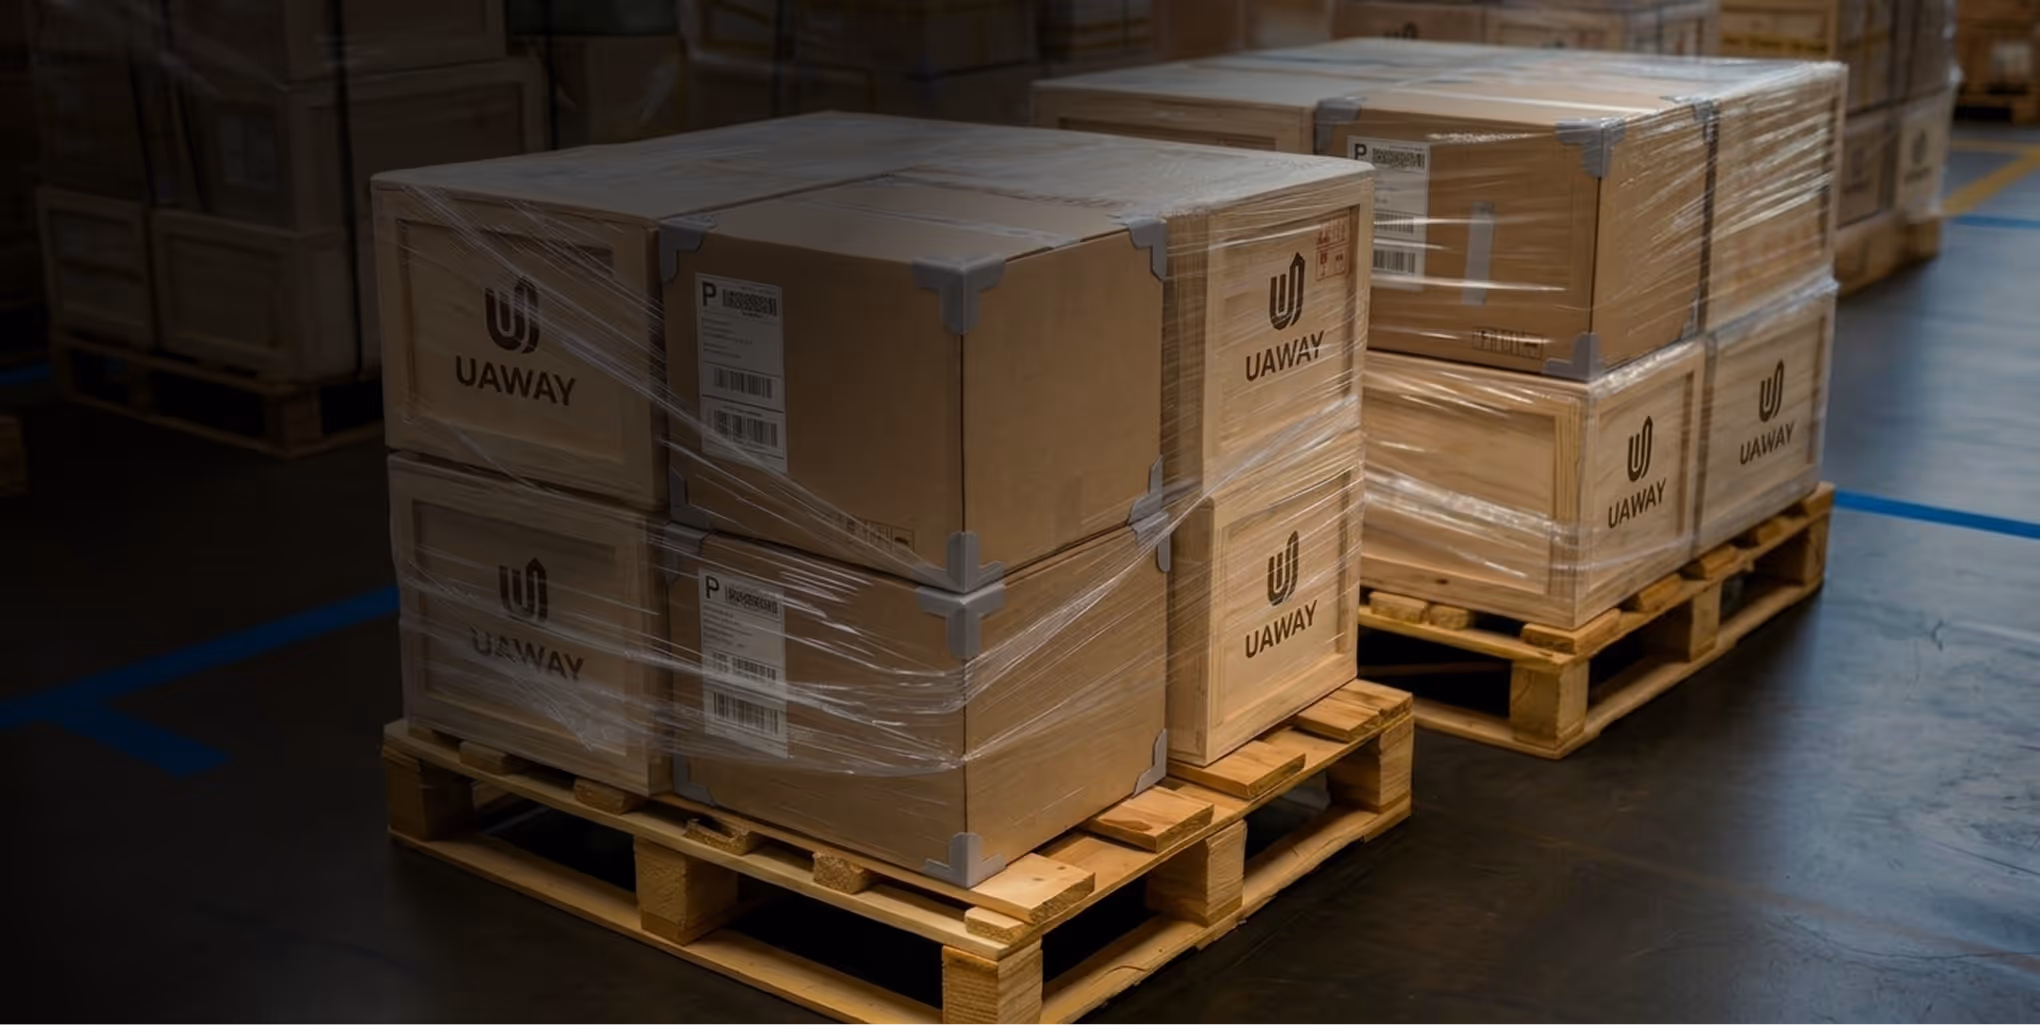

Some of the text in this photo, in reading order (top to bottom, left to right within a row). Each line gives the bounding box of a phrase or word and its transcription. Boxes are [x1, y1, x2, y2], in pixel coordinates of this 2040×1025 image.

[1354, 143, 1368, 161] P
[702, 280, 717, 307] P
[1246, 330, 1325, 382] UAWAY
[456, 354, 577, 407] UAWAY
[1740, 420, 1795, 465] UAWAY
[1608, 477, 1667, 529] UAWAY
[705, 575, 720, 599] P
[1245, 599, 1318, 659] UAWAY
